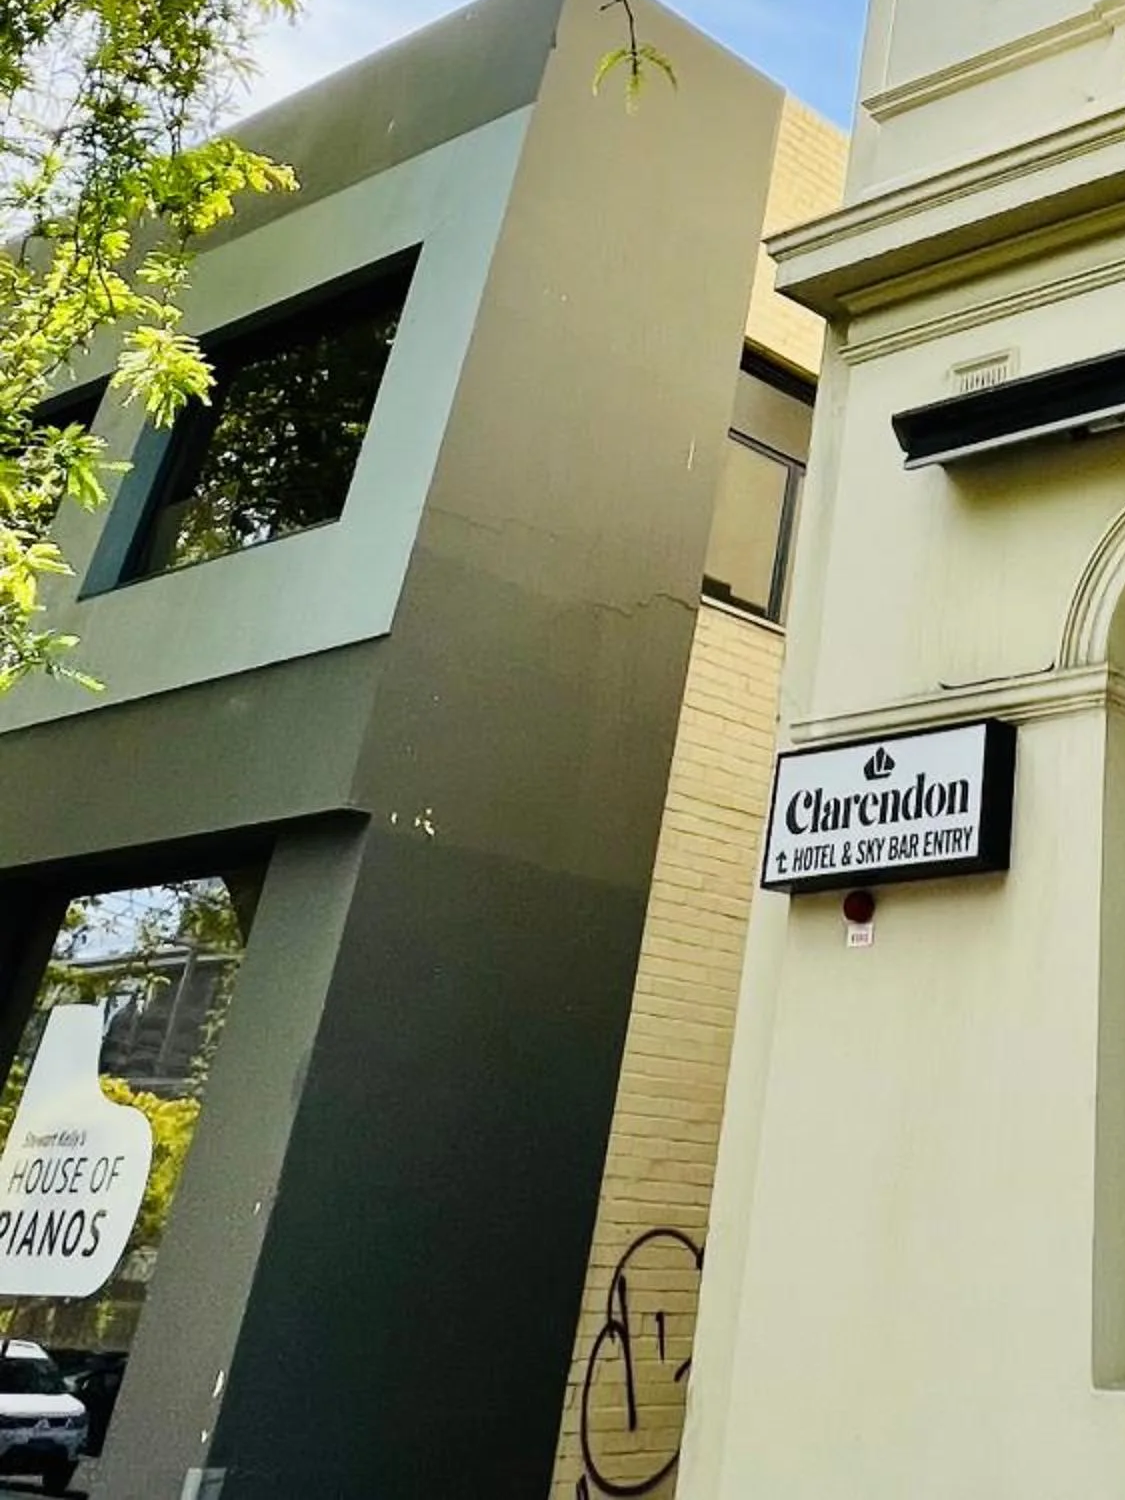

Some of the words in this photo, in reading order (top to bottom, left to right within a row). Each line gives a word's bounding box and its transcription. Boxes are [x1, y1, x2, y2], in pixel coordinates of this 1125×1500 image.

[786, 773, 969, 835] Clarendon
[792, 844, 836, 871] HOTEL
[841, 842, 851, 865] &
[856, 836, 885, 864] SKY
[888, 832, 919, 859] BAR
[923, 826, 973, 856] ENTRY
[8, 1156, 88, 1194] HOUSE
[90, 1156, 124, 1194] OF
